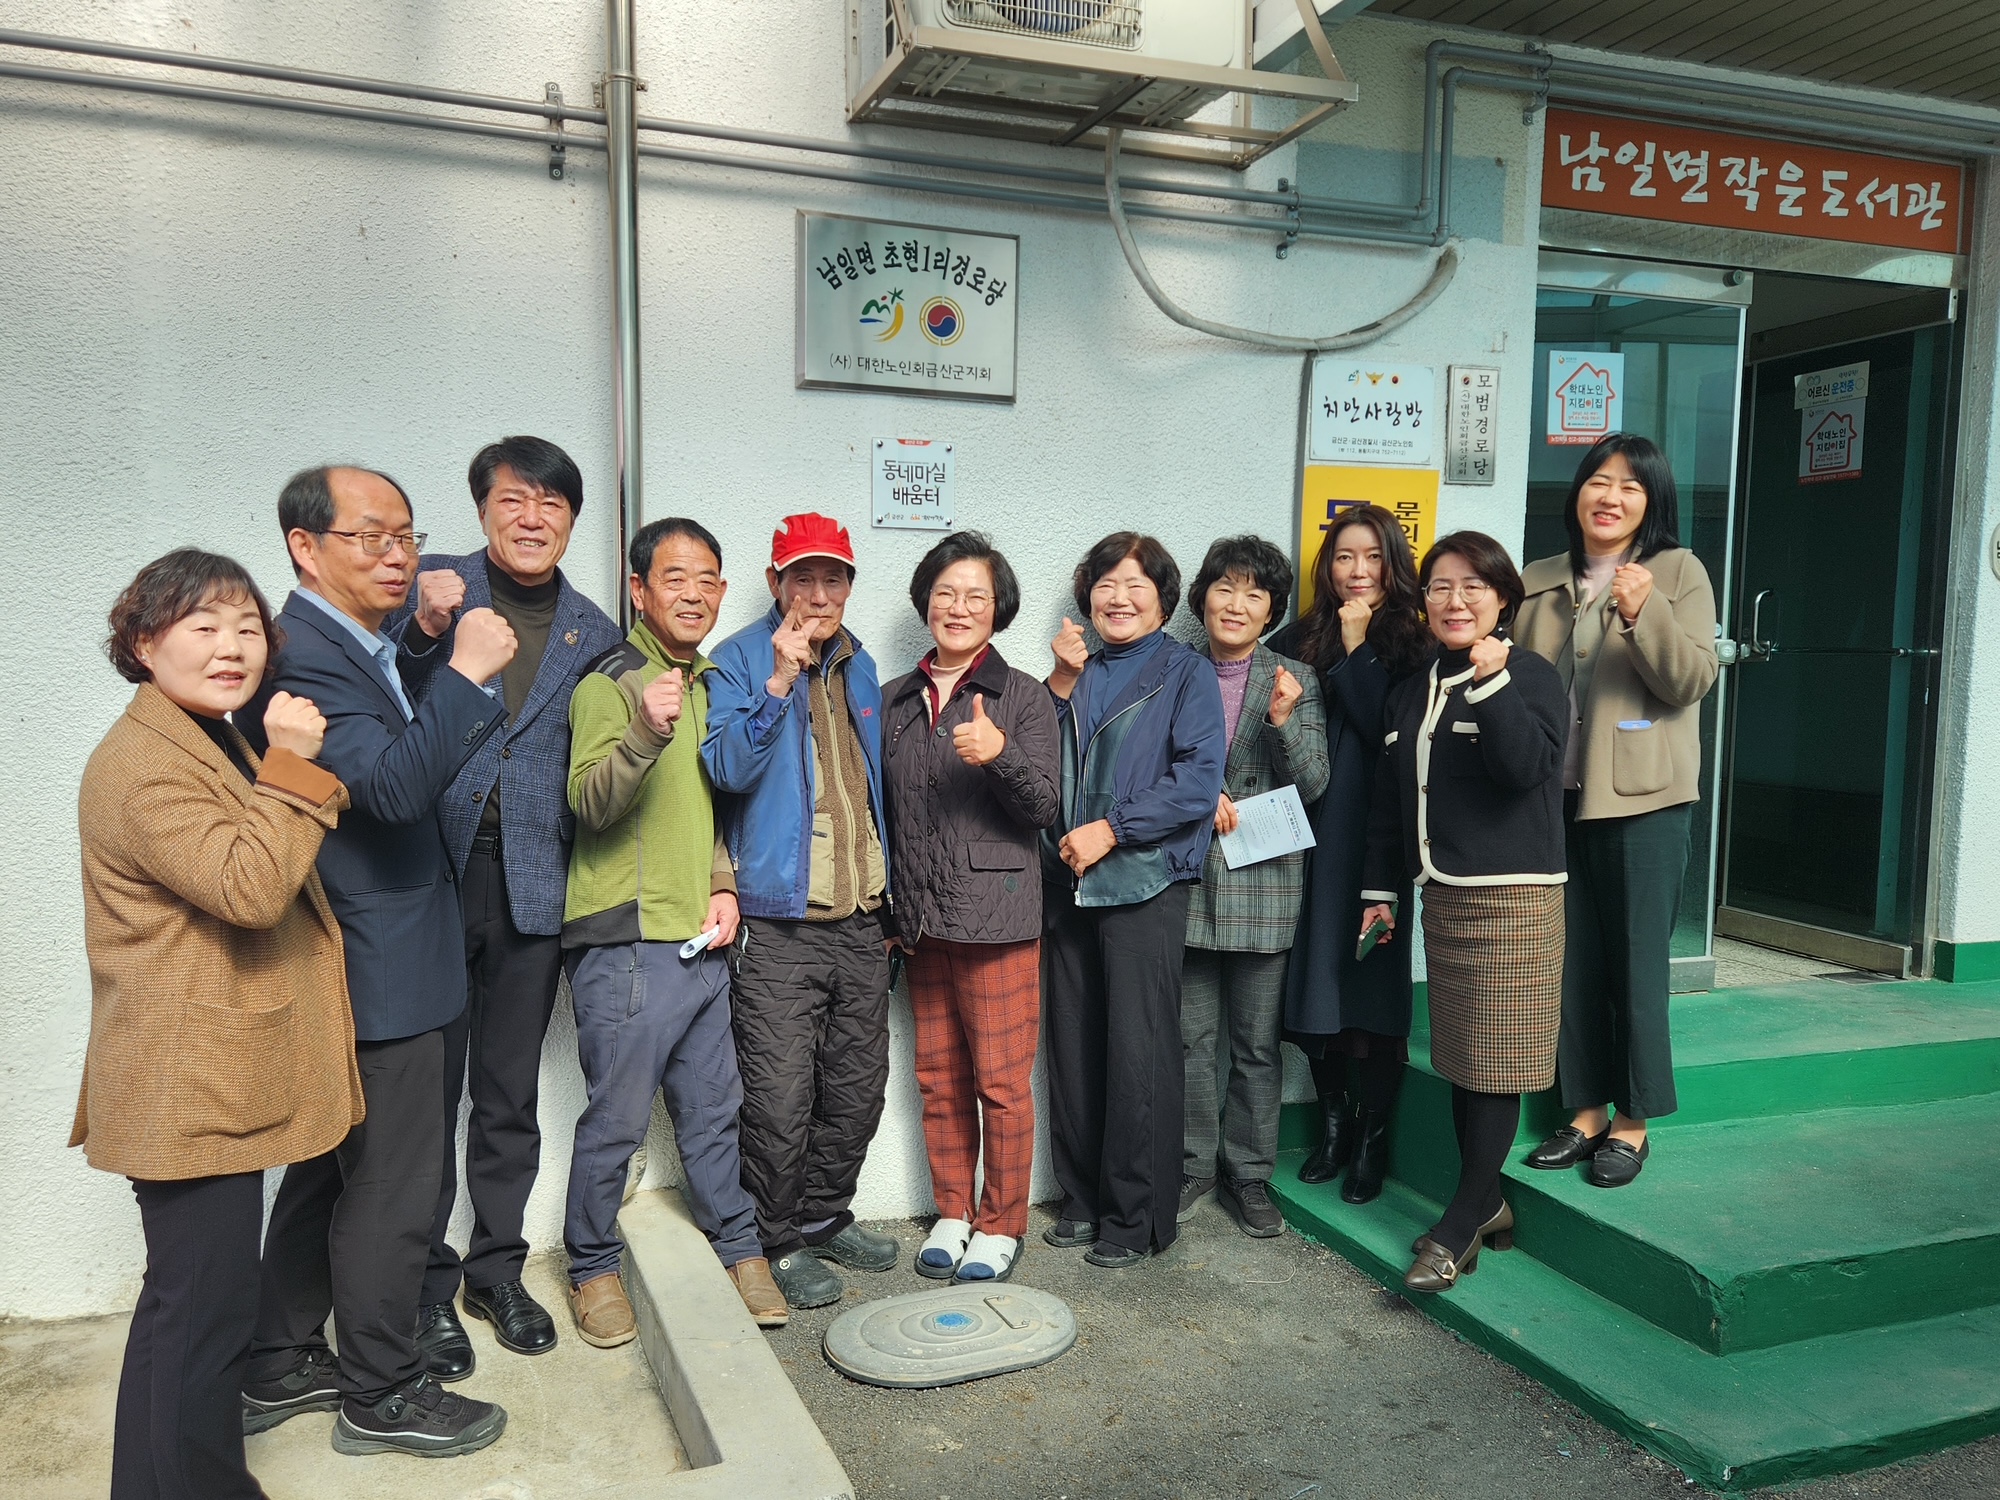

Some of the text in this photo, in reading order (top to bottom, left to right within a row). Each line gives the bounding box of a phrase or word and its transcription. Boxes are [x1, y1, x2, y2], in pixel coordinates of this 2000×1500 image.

[1559, 131, 1947, 231] 남일면작은도서관
[816, 239, 1007, 306] 남일면 초현1리경로당
[829, 353, 991, 382] (사) 대한노인회금산군지회
[1569, 384, 1604, 396] 학대노인
[1807, 383, 1830, 399] 어르신
[1831, 379, 1855, 396] 운전중
[1323, 396, 1423, 428] 치안사랑방
[1473, 373, 1493, 477] 모범경로당
[1816, 427, 1847, 441] 학대노인
[882, 459, 946, 484] 동네마실
[893, 484, 940, 506] 배움터
